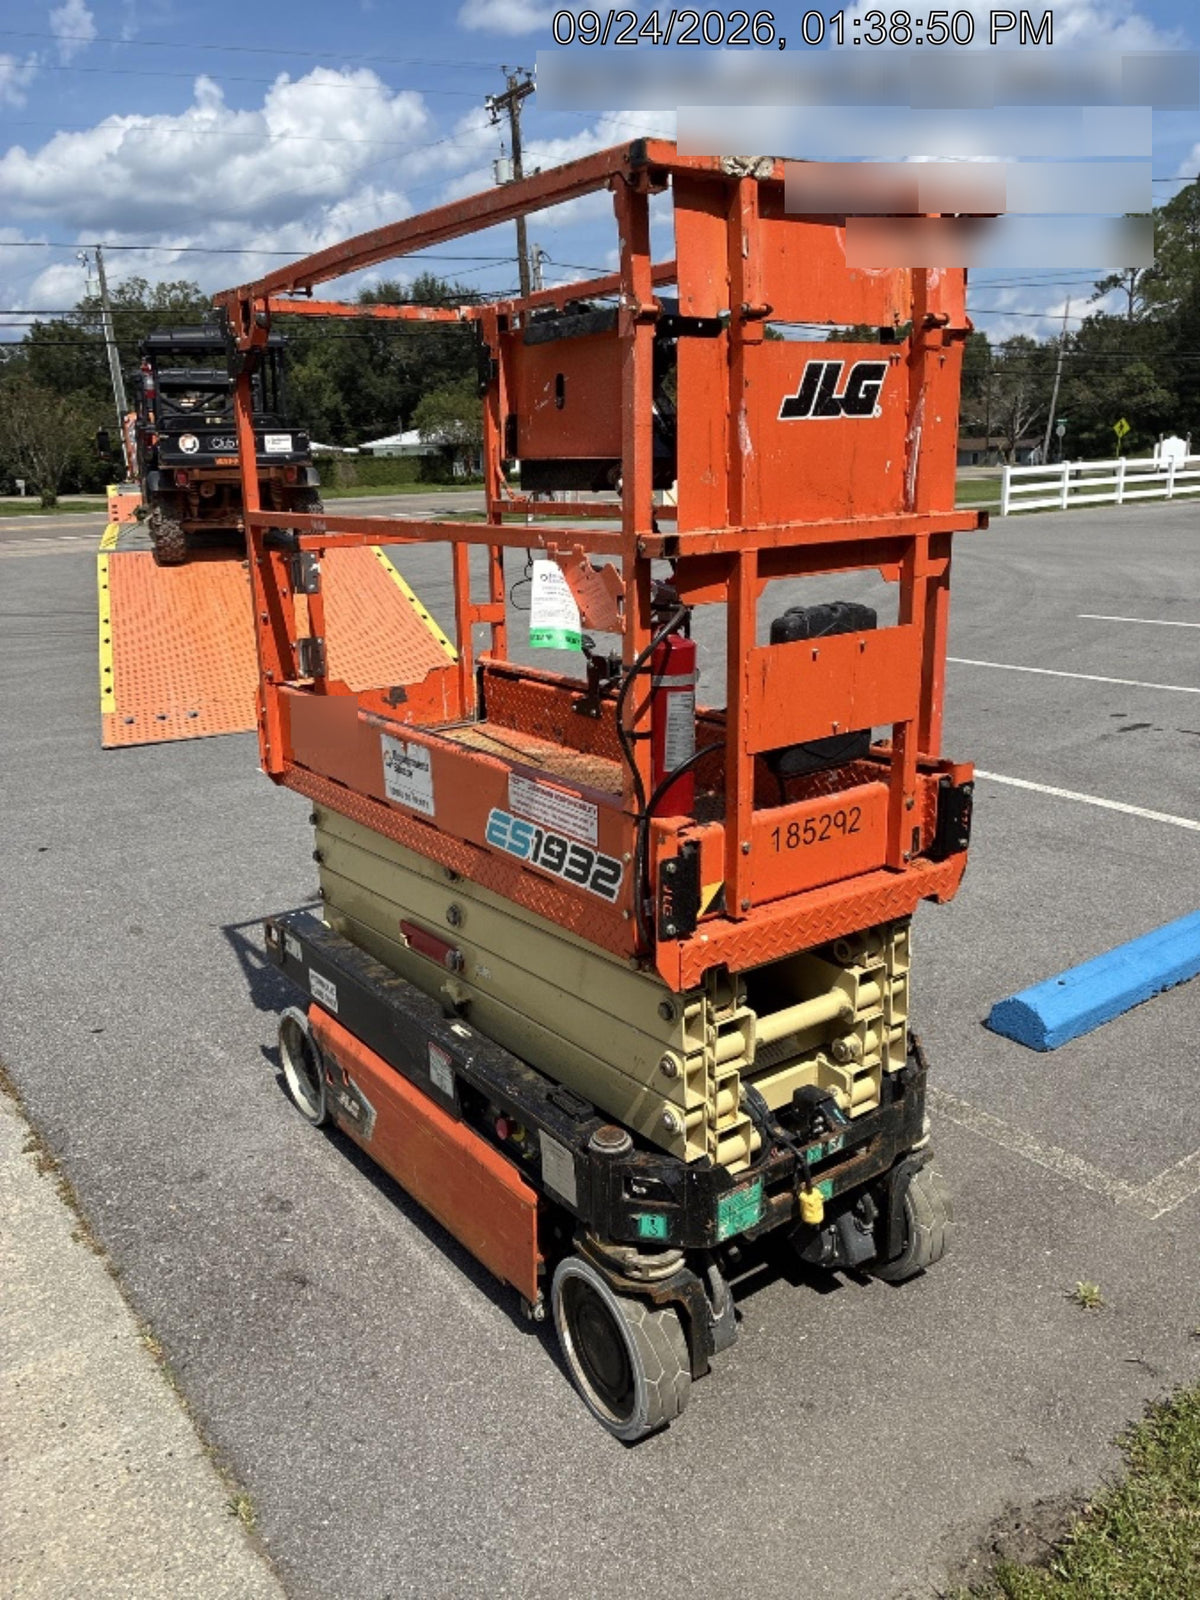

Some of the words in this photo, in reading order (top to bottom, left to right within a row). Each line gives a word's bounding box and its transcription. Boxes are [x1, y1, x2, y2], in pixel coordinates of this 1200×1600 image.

[777, 360, 890, 420] JLG
[486, 808, 623, 903] ES1932
[771, 805, 862, 853] 185292
